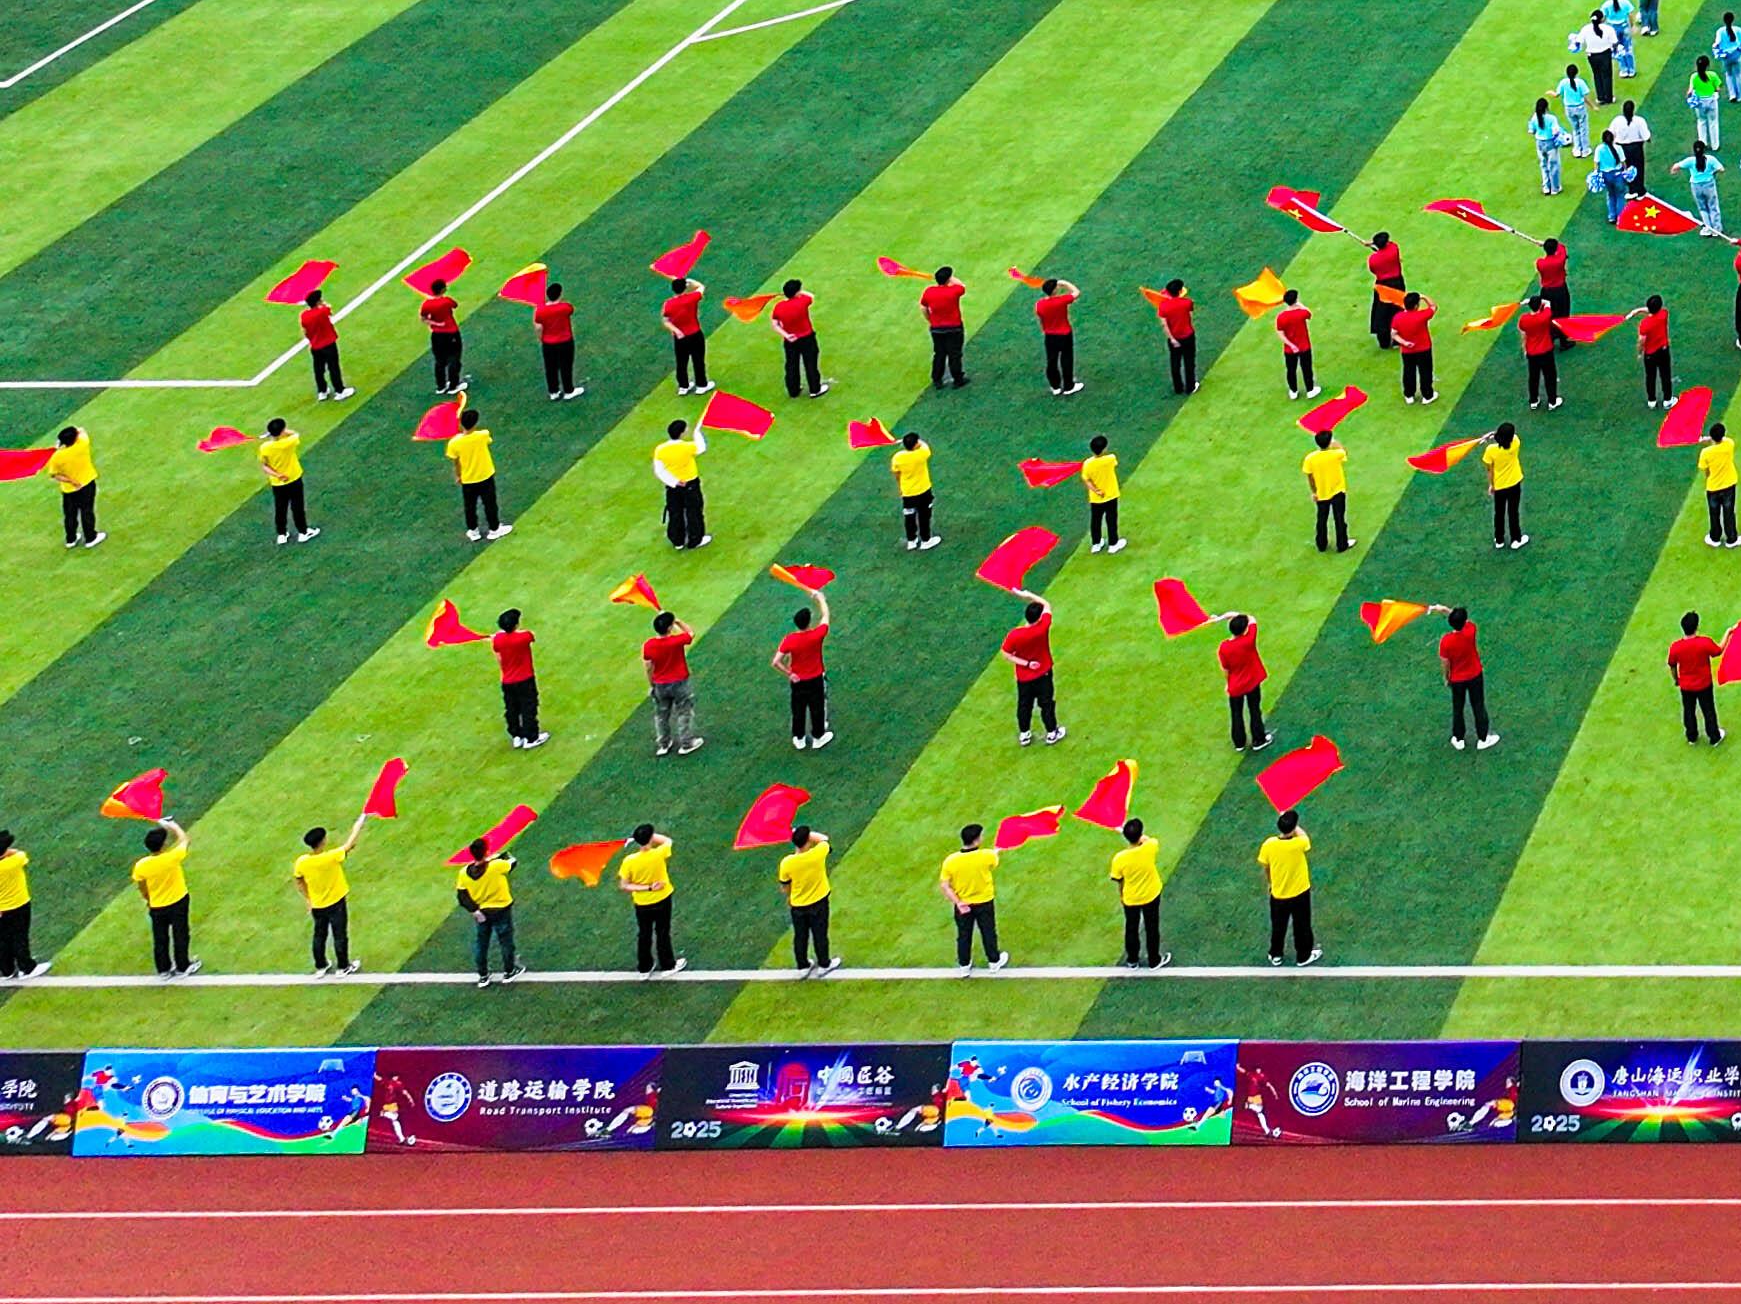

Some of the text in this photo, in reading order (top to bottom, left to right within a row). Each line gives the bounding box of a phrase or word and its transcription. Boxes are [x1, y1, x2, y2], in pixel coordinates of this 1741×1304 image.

[477, 1078, 616, 1102] 道路运输学院
[1062, 1072, 1179, 1092] 水产经济学院
[1344, 1069, 1476, 1092] 海洋工程学院
[189, 1083, 327, 1105] 体育与艺术学院
[1091, 1098, 1099, 1107] of
[1344, 1097, 1374, 1107] School
[1379, 1097, 1389, 1106] of
[1424, 1097, 1476, 1108] Engineering
[479, 1106, 612, 1117] Road Transport Institute
